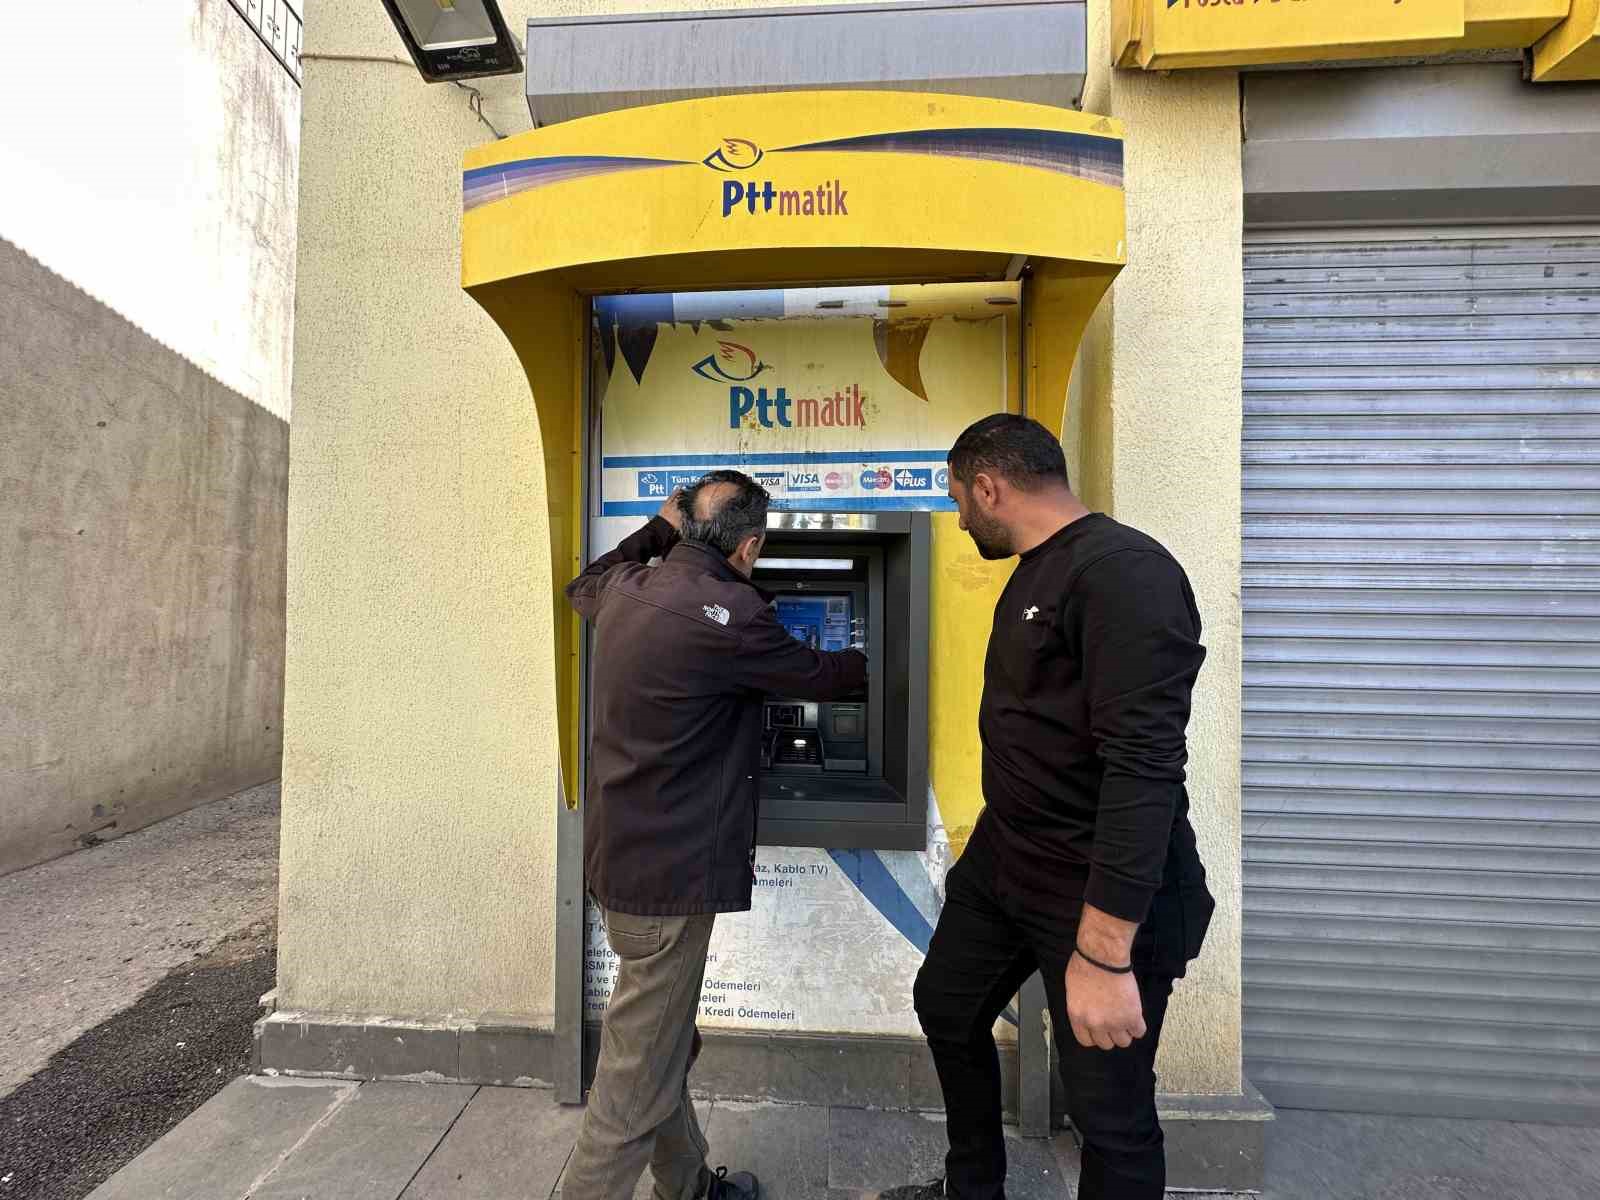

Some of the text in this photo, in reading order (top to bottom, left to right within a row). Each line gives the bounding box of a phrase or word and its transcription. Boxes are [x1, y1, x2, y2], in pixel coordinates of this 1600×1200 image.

[760, 478, 780, 486] VISA
[792, 473, 820, 484] VISA
[903, 478, 927, 487] PLUS
[649, 484, 665, 495] Ptt
[753, 864, 828, 876] az, Kablo TV)
[704, 978, 761, 992] Ödemeleri
[587, 988, 726, 1003] ablo eleri
[705, 1006, 734, 1017] Kredi
[737, 1006, 796, 1020] Ödemeleri
